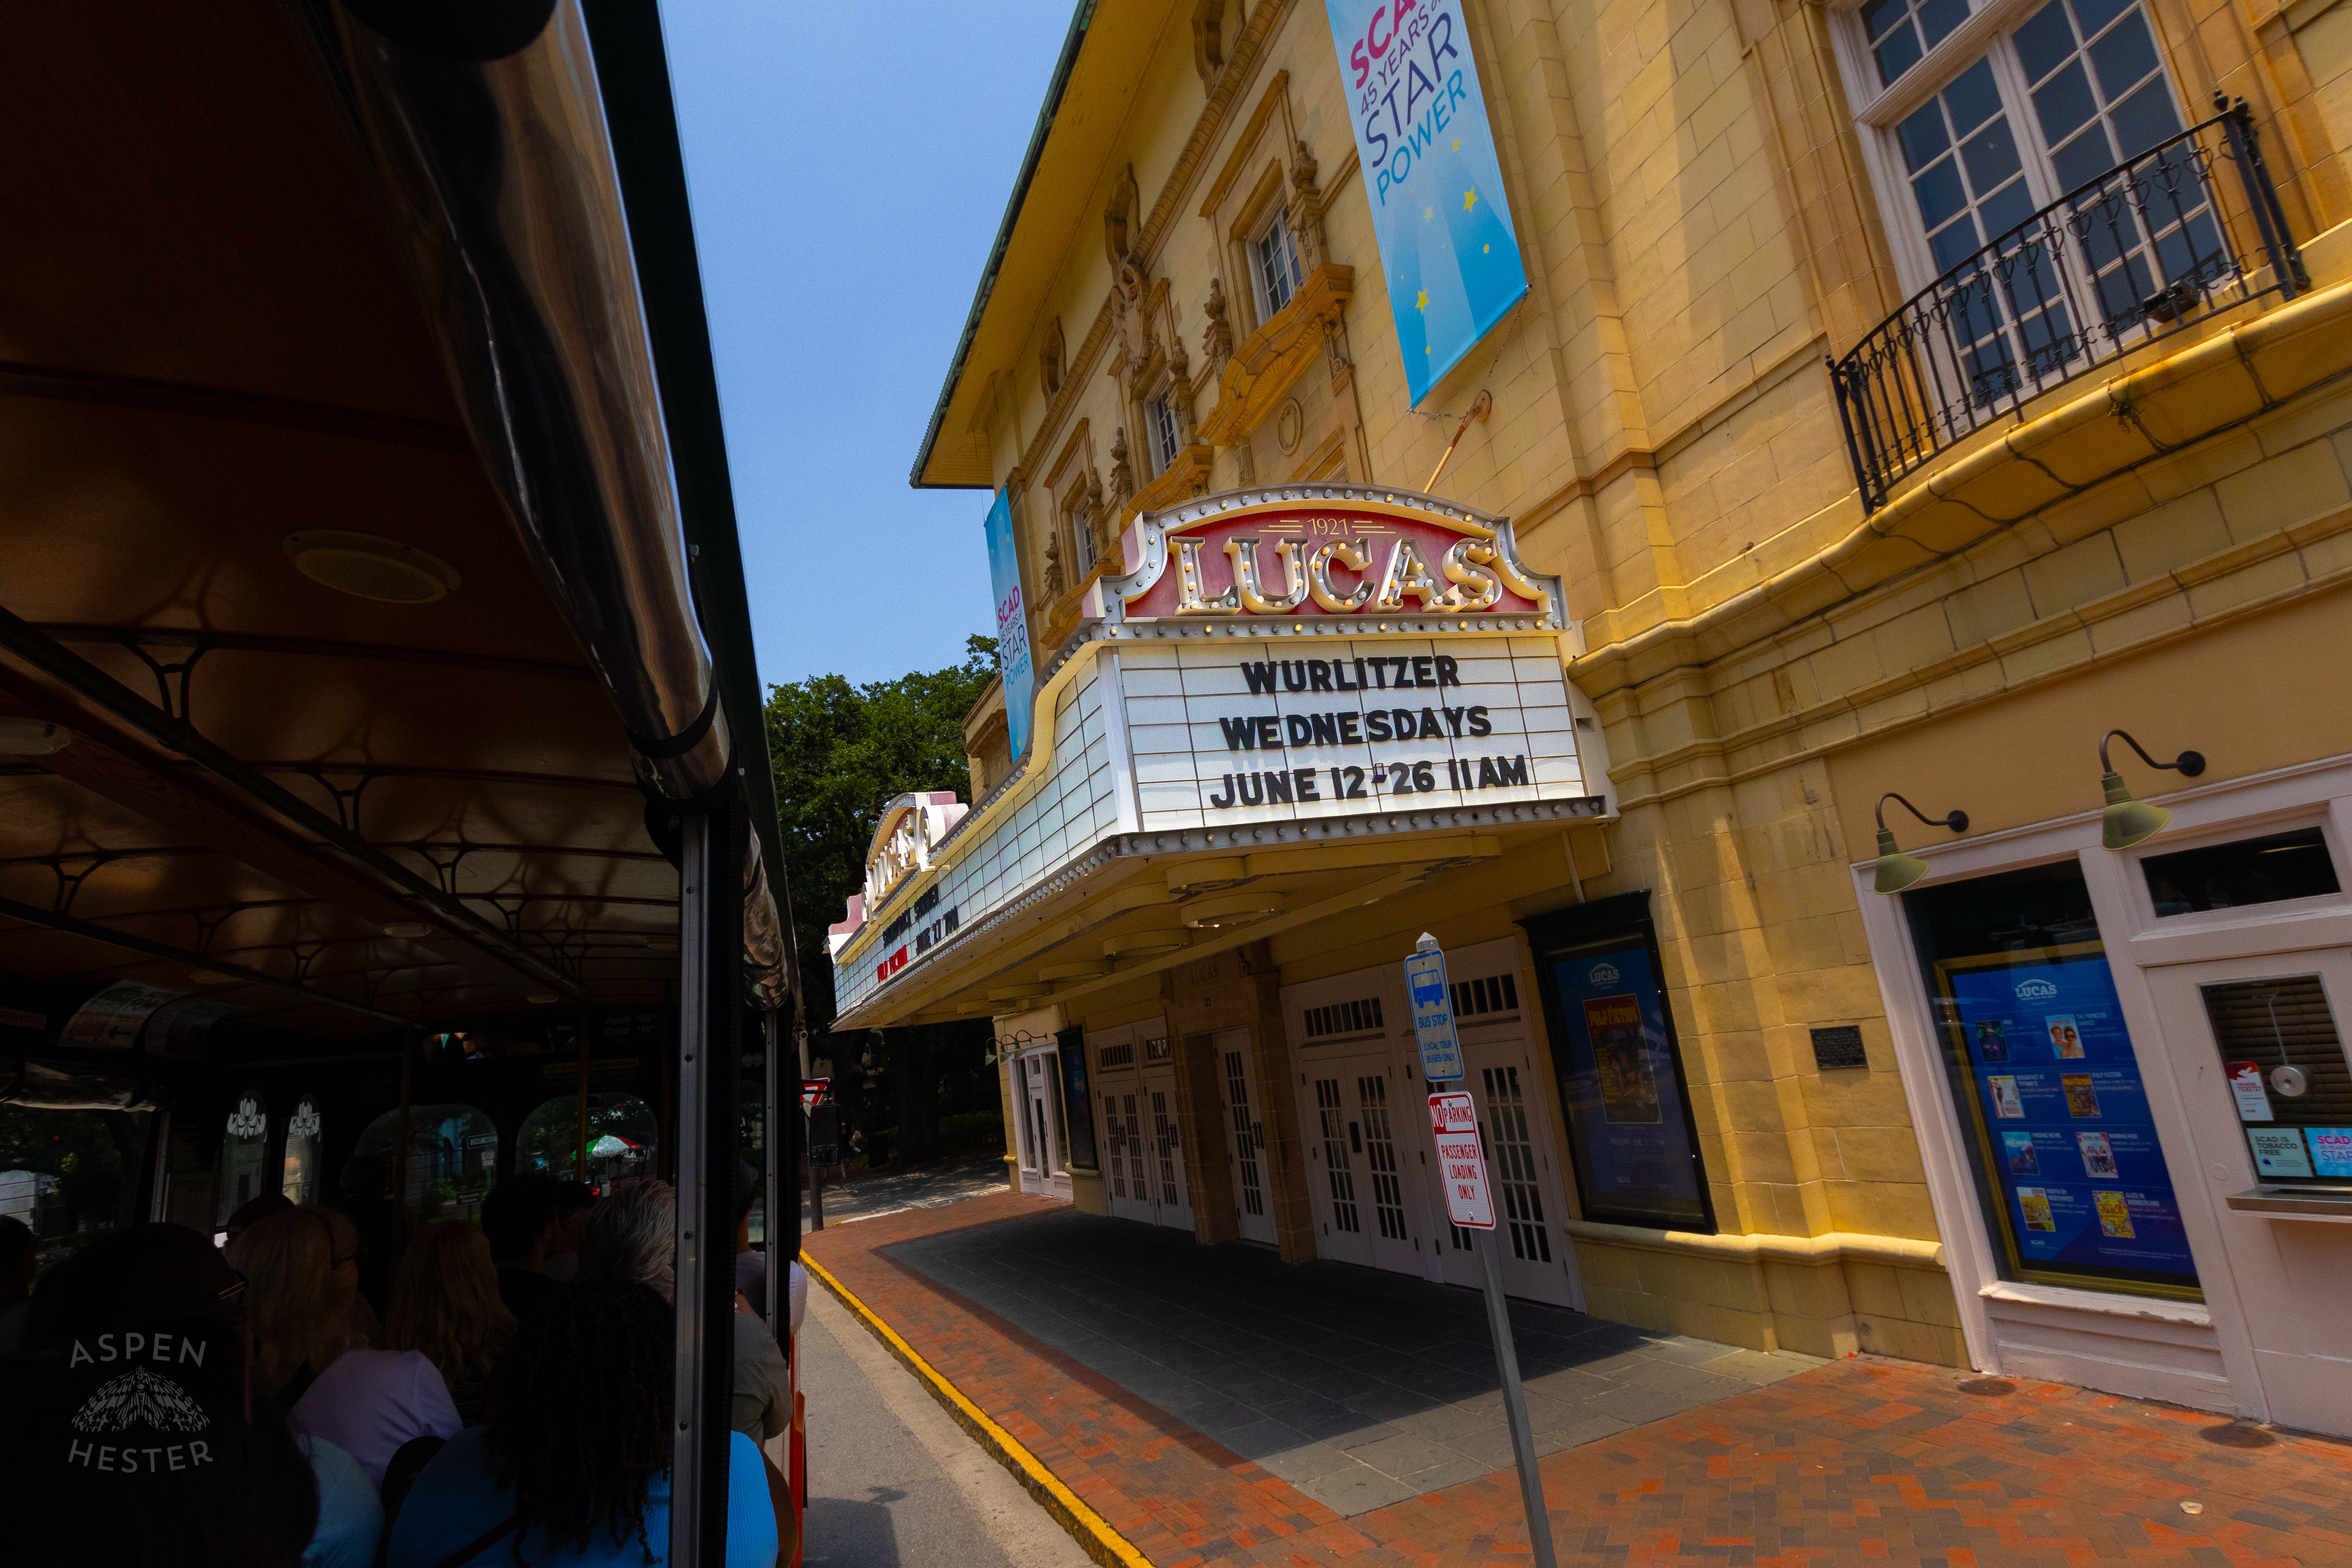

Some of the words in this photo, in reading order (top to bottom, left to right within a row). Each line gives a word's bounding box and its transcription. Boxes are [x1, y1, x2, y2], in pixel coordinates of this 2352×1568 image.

[1361, 81, 1378, 115] 45
[1378, 4, 1429, 86] YEARS
[1366, 12, 1458, 167] STAR
[1377, 69, 1466, 206] POWER
[1307, 518, 1349, 537] 1921
[1167, 537, 1502, 616] LUCAS
[998, 586, 1020, 630] SCAD
[1001, 631, 1006, 643] 45
[1005, 613, 1019, 636] YEARS
[1002, 624, 1027, 670] STAR
[1006, 652, 1030, 690] POWER
[1241, 655, 1461, 695] WURLITZER
[1219, 706, 1492, 751] WEDNESDAYS
[1210, 767, 1321, 809] JUNE
[1331, 760, 1436, 800] 12-26
[1589, 968, 1619, 982] LUCAS
[2015, 984, 2057, 997] LUCAS
[605, 1016, 631, 1025] Adult
[1418, 1016, 1431, 1028] BUS
[1431, 1013, 1448, 1027] STOP
[1588, 1009, 1609, 1026] PULP
[1606, 1003, 1638, 1024] FICTION
[605, 1027, 630, 1036] Child
[1423, 1042, 1439, 1051] LOCAL
[1439, 1040, 1453, 1049] TOUR
[1426, 1054, 1442, 1063] BUSES
[1442, 1053, 1455, 1061] ONLY
[1430, 1104, 1444, 1128] NO
[1443, 1106, 1472, 1123] PARKING
[1441, 1144, 1478, 1159] PASSENGER
[2317, 1135, 2351, 1145] SCAD
[1449, 1164, 1477, 1180] LOADING
[1458, 1185, 1476, 1200] ONLY
